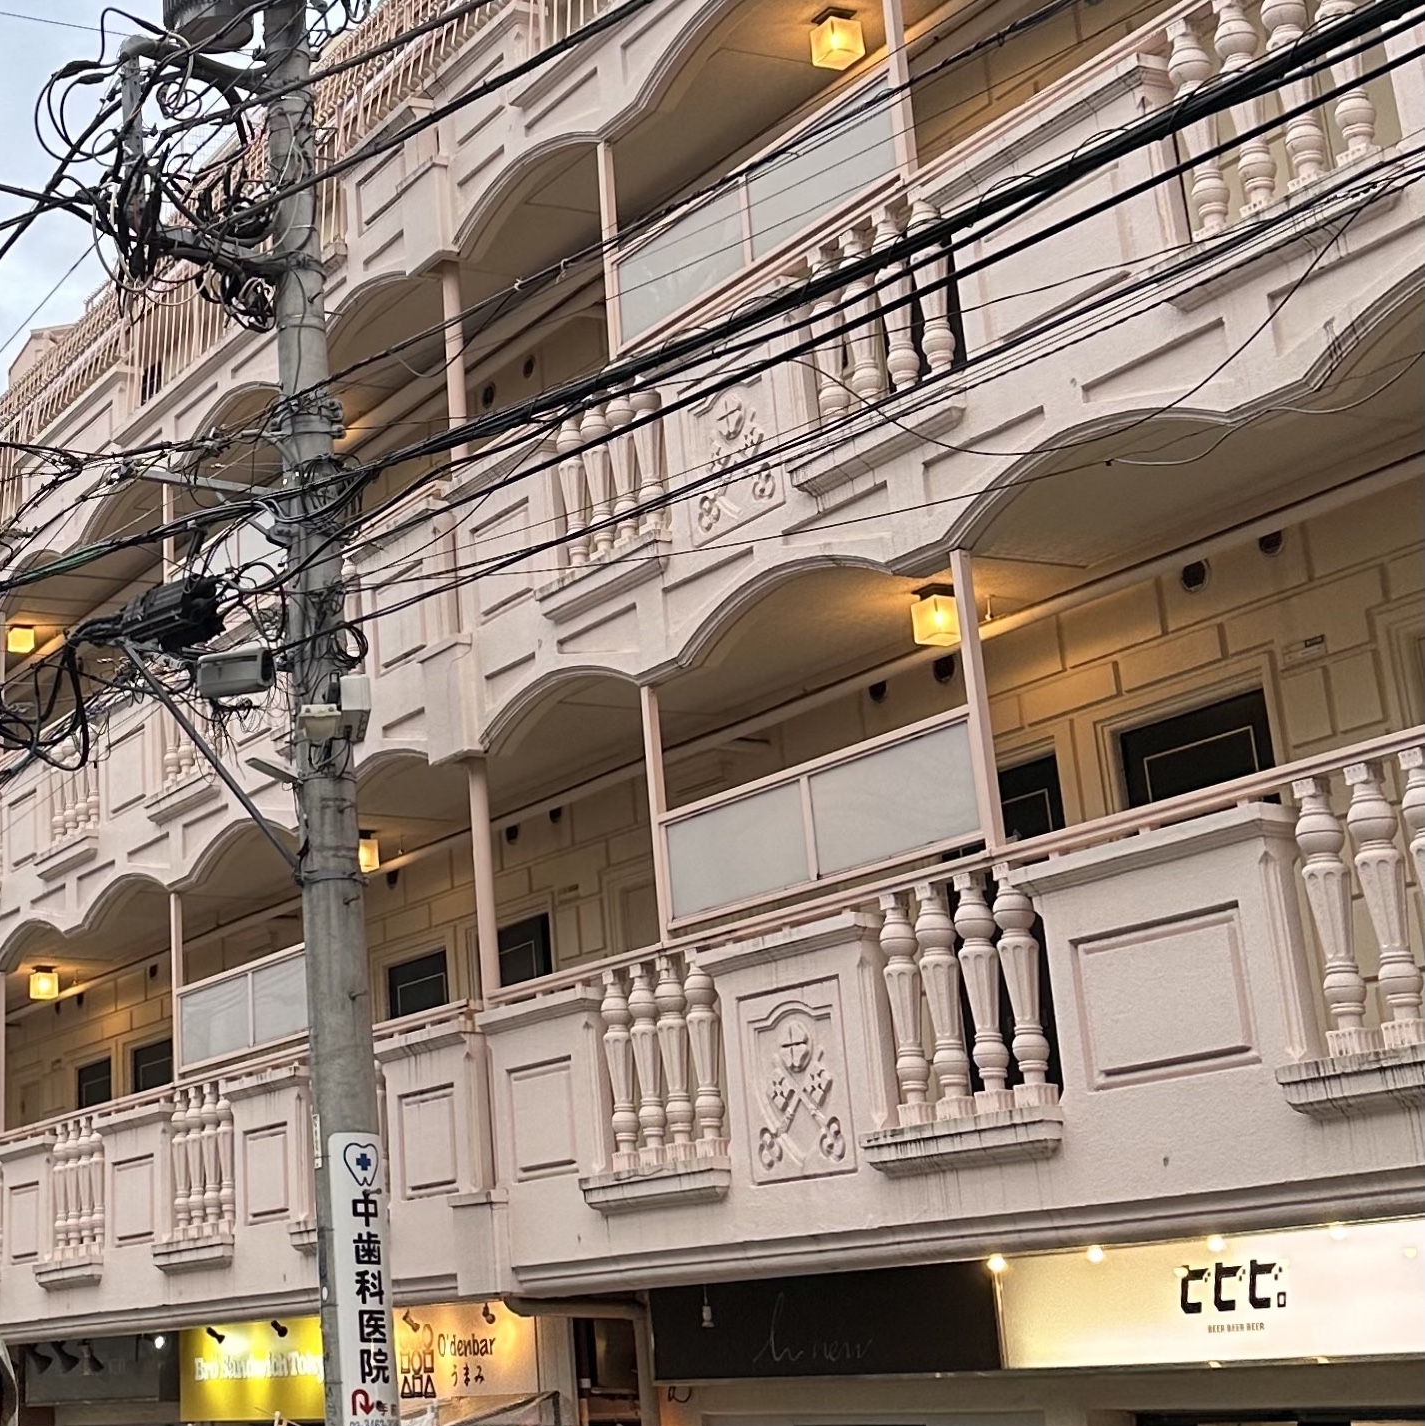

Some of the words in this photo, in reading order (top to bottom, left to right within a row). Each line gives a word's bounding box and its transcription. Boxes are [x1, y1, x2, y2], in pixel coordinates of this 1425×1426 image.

[352, 1191, 390, 1384] 中歯科医院
[1246, 1322, 1265, 1332] BEER
[437, 1333, 496, 1357] O'denbar
